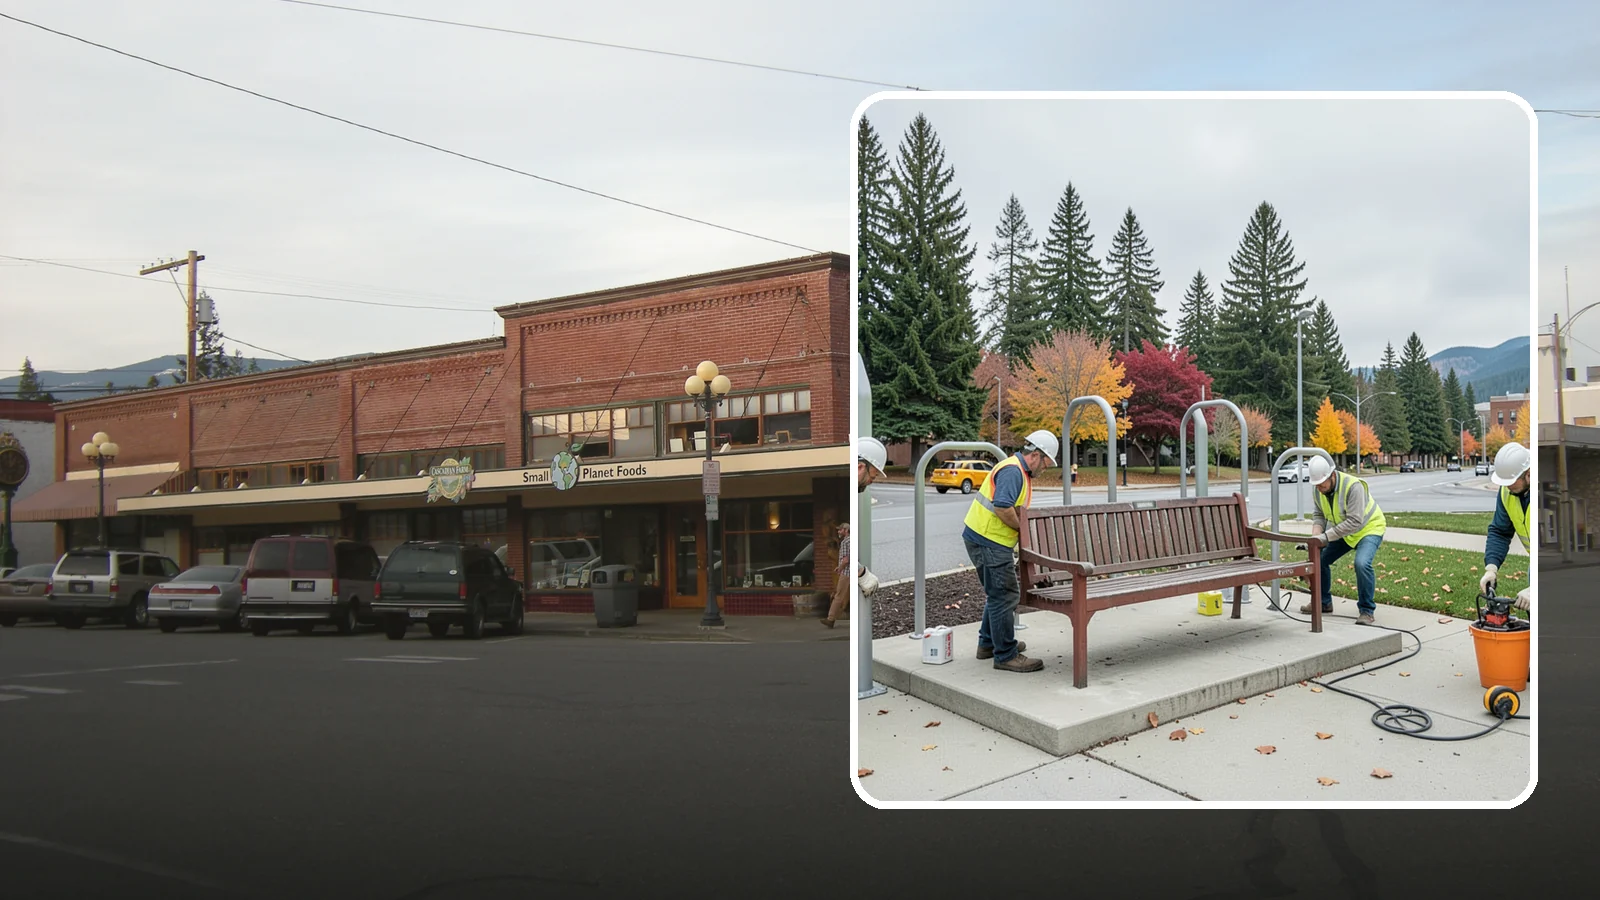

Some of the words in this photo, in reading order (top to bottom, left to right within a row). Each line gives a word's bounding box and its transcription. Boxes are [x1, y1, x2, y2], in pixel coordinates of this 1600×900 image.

[523, 471, 549, 483] Small
[583, 467, 614, 479] Planet
[617, 464, 647, 477] Foods
